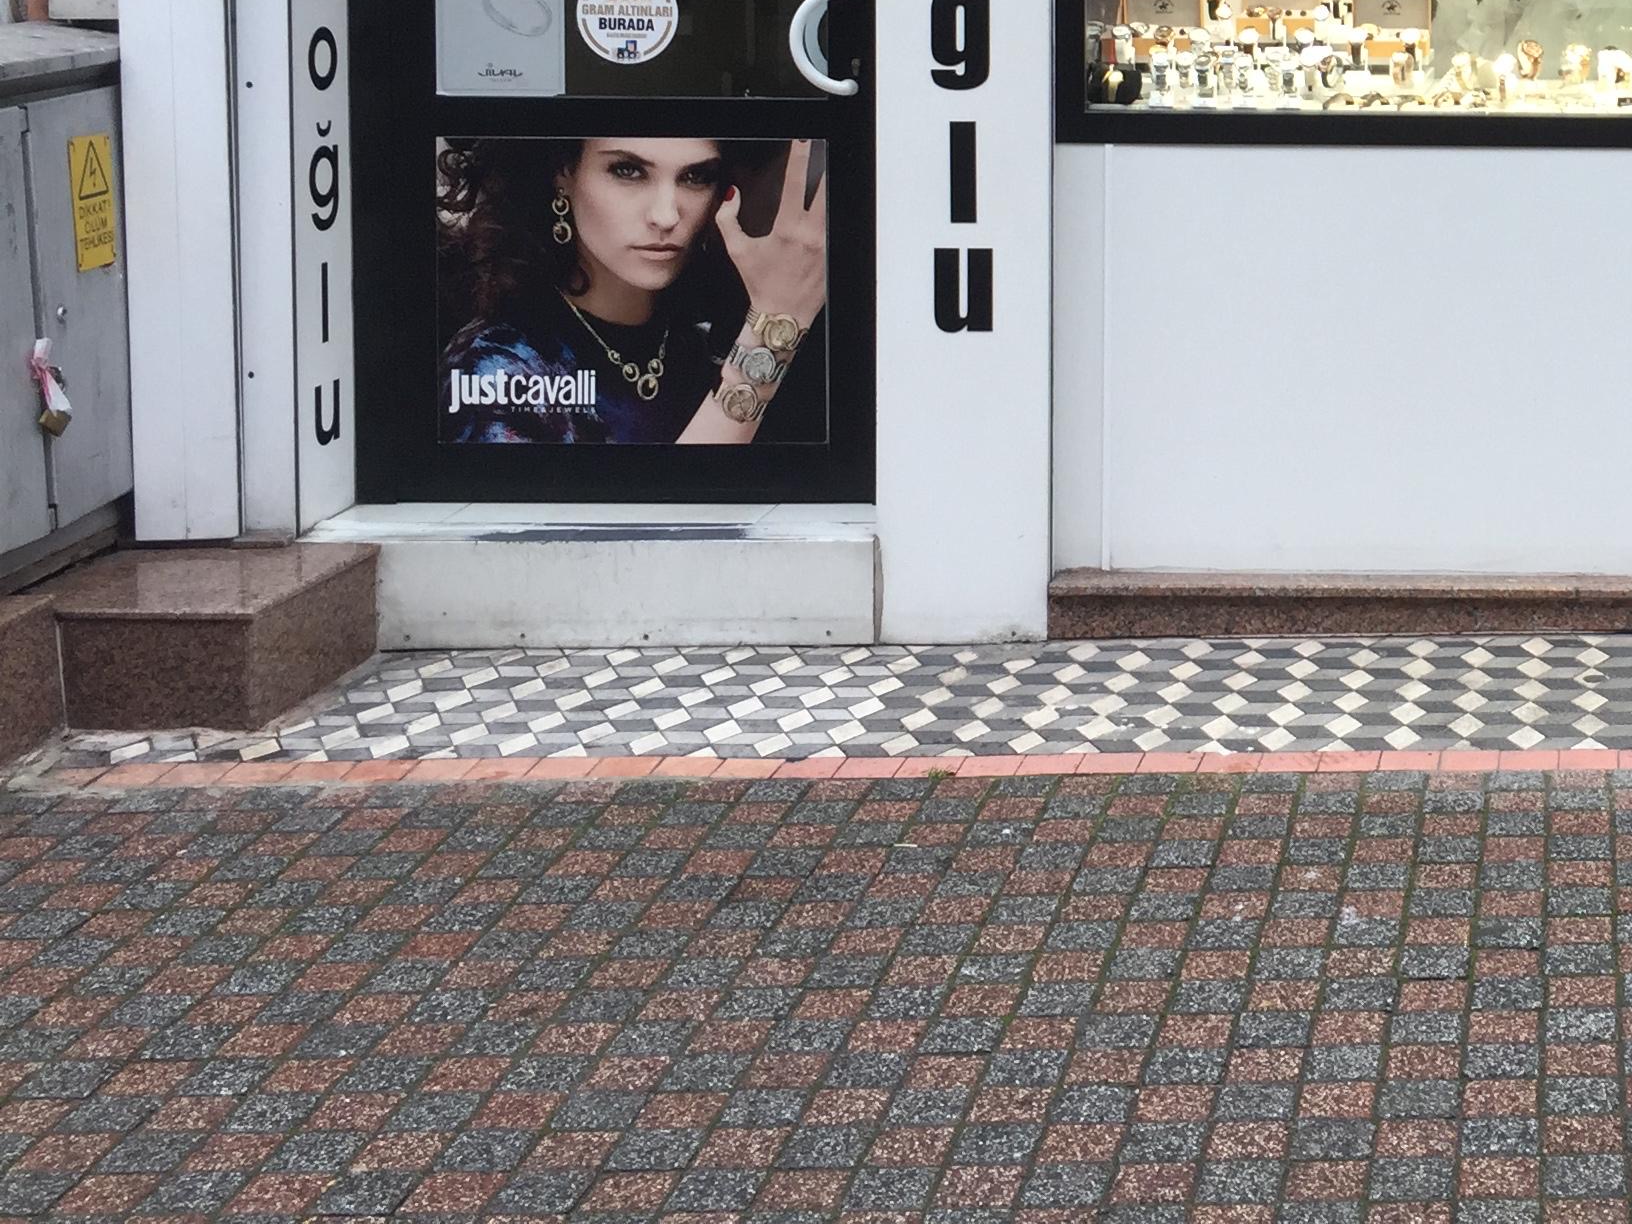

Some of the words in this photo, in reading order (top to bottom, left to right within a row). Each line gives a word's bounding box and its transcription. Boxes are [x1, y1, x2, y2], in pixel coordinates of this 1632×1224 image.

[582, 3, 615, 16] GRAM
[617, 5, 673, 18] ALTINLARI
[598, 17, 655, 32] BURADA
